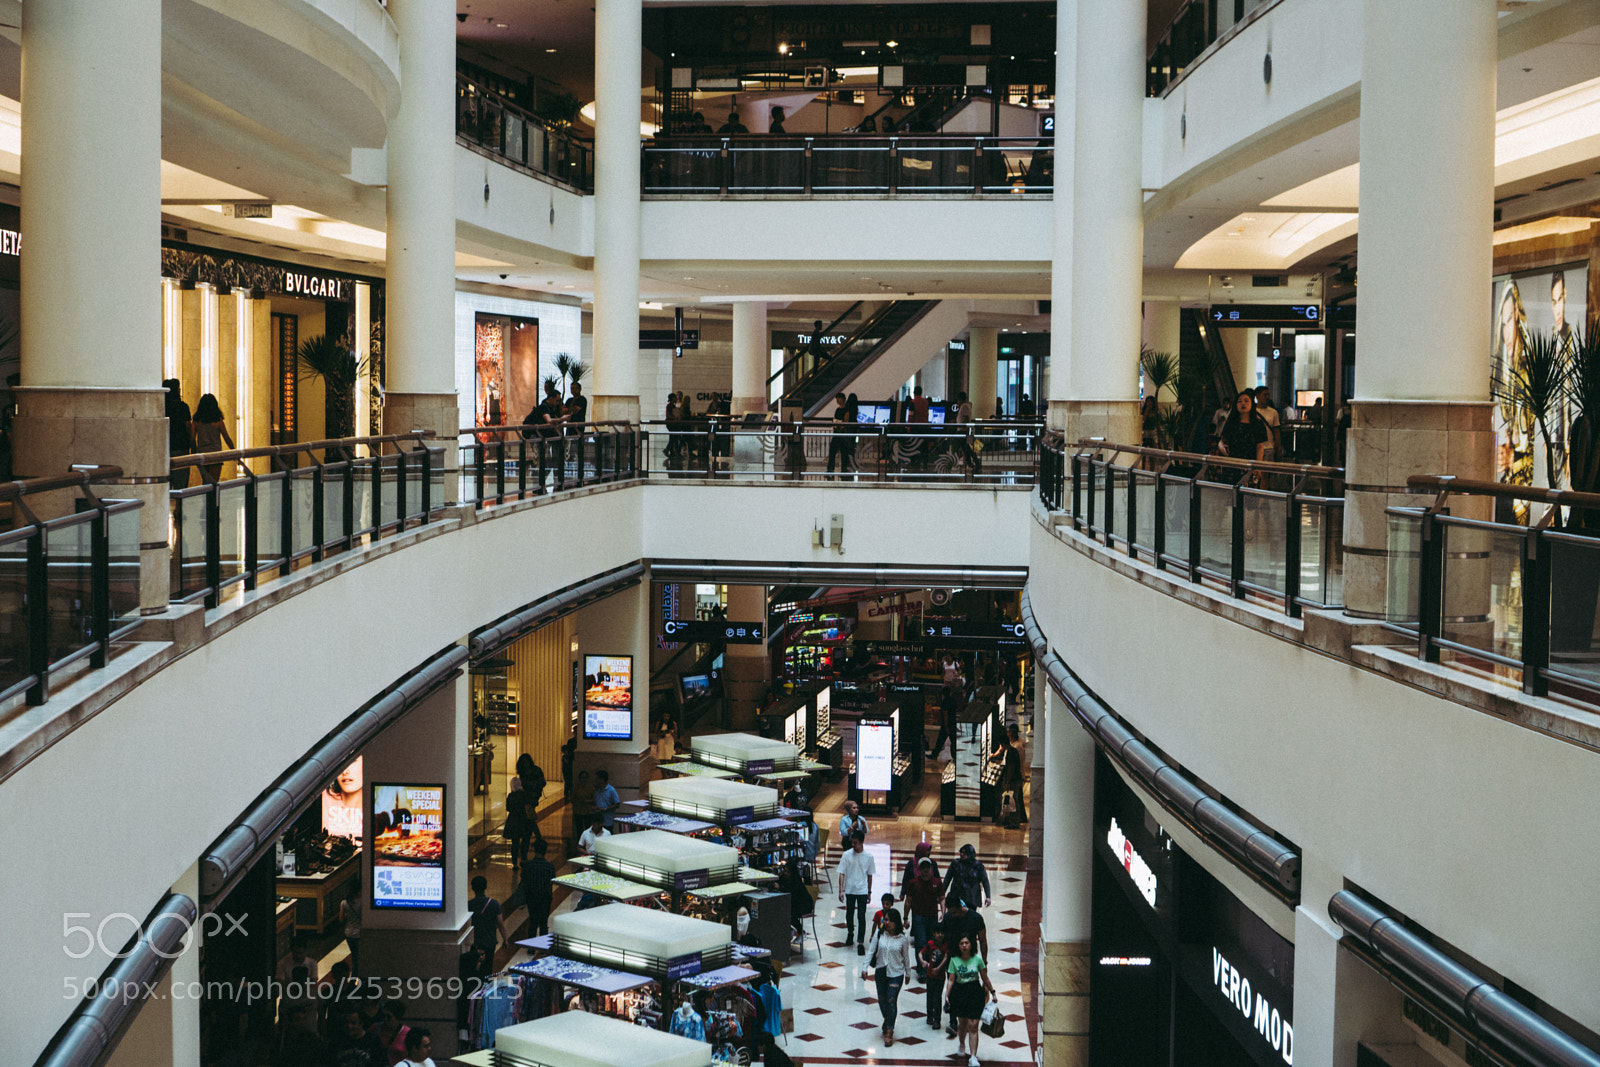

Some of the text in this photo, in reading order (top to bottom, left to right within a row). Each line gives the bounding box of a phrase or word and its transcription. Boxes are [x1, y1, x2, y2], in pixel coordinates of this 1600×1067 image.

[1044, 117, 1054, 130] 2
[286, 272, 341, 298] BVLGARI
[1305, 305, 1318, 320] G
[1273, 348, 1280, 360] 9
[665, 621, 676, 634] C
[1014, 624, 1026, 637] C
[406, 790, 441, 801] WEEKEND
[411, 800, 441, 811] SPECIAL
[427, 815, 441, 825] ALL
[1213, 946, 1294, 1066] VERO MOD
